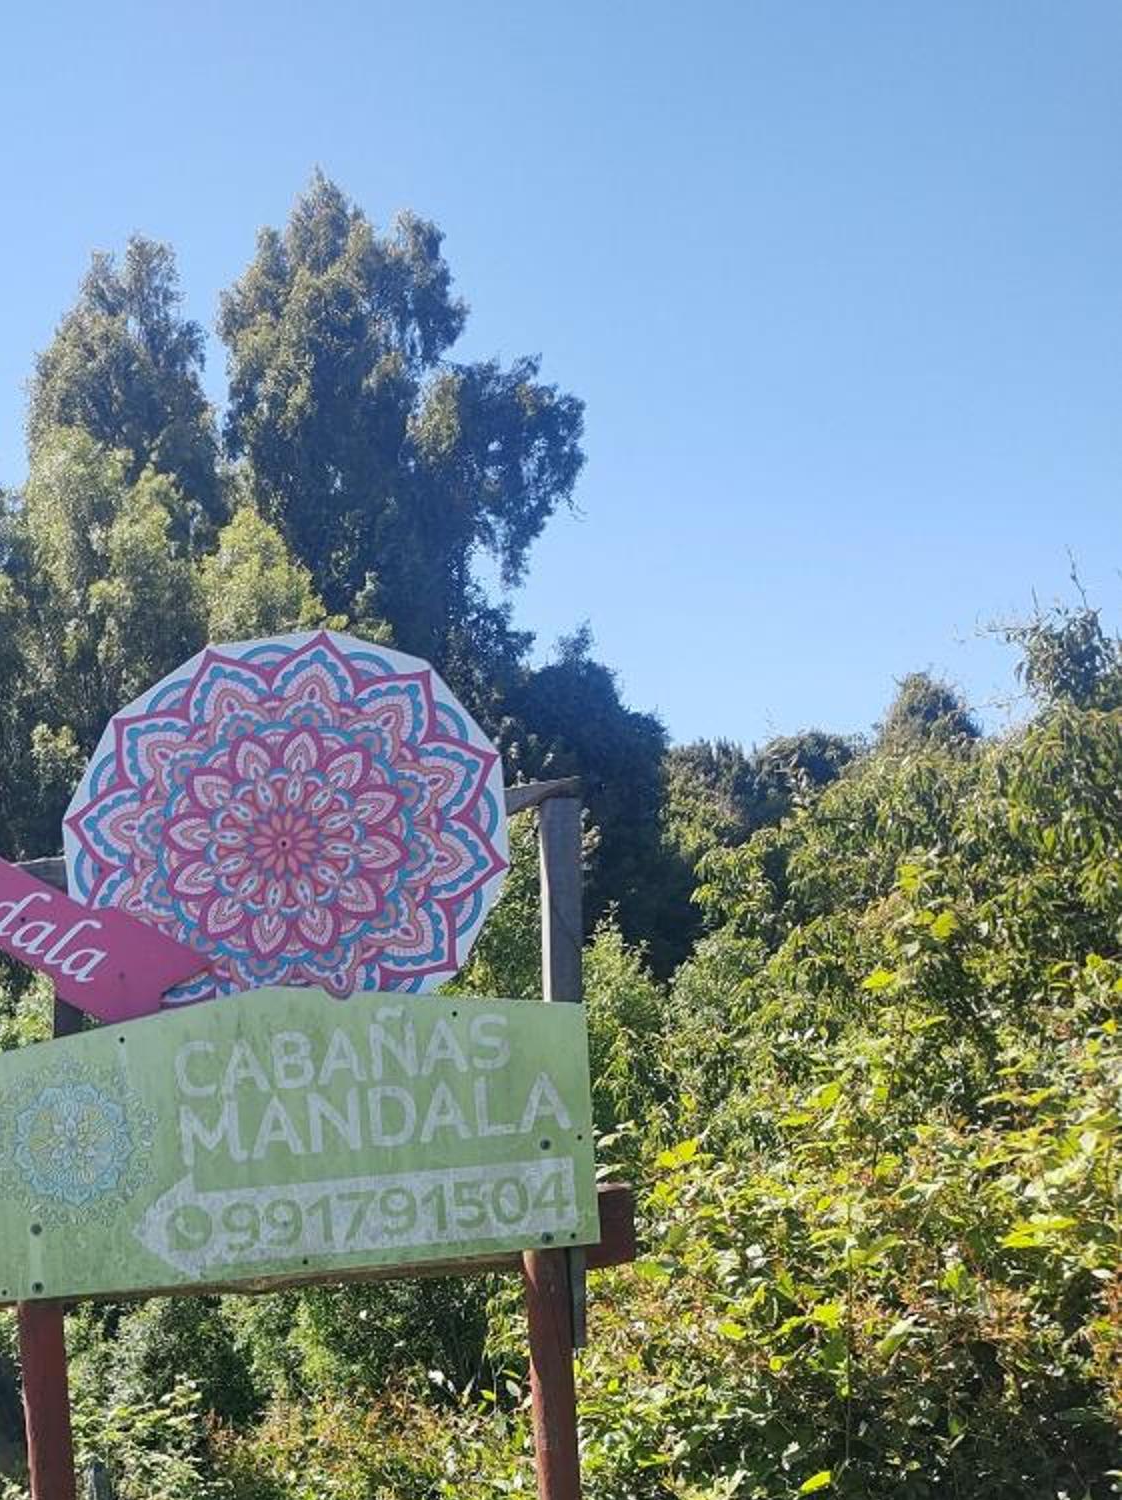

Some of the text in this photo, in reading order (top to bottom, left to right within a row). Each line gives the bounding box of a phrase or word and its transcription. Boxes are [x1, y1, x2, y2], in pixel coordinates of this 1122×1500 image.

[176, 1005, 511, 1097] CABAÑAS
[179, 1071, 572, 1167] MANDALA
[221, 1169, 570, 1252] 991791504
